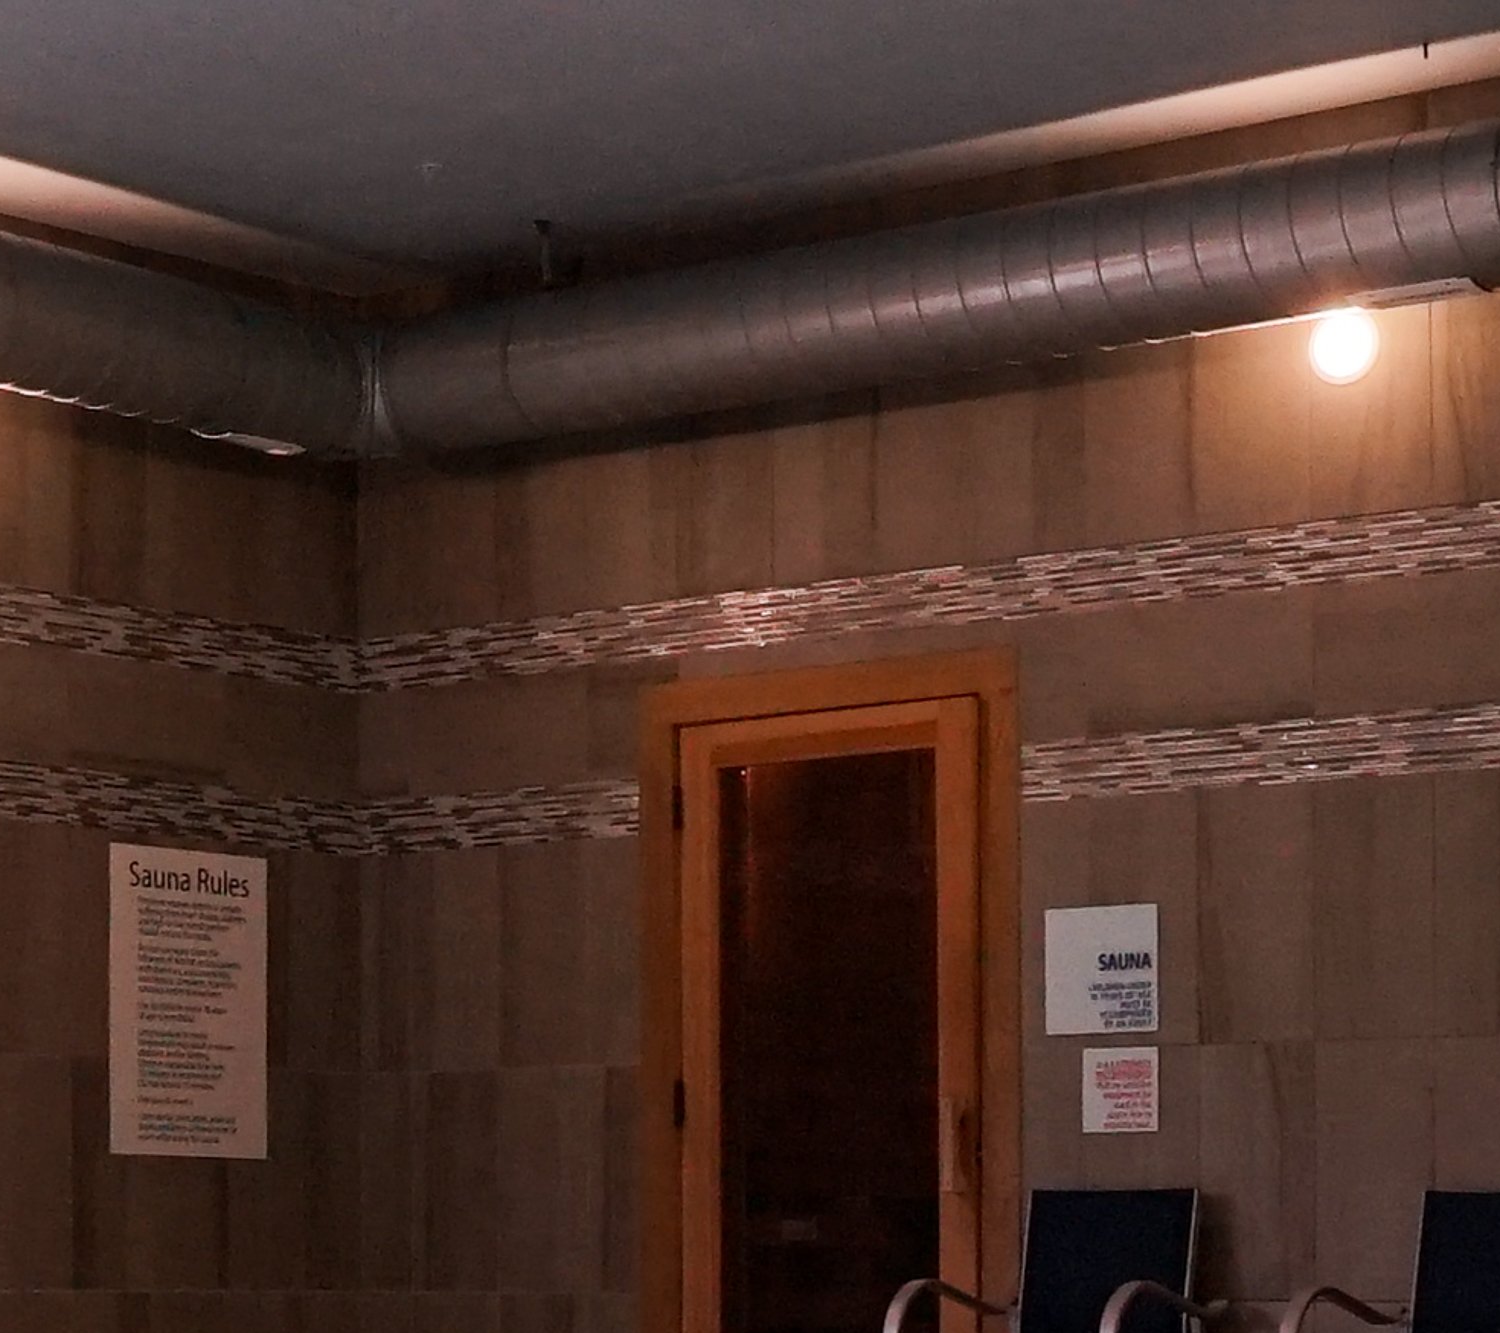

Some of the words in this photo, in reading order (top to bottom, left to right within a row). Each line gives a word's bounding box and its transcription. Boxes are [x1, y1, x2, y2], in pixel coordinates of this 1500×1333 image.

[129, 861, 190, 892] Sauna
[197, 867, 250, 898] Rules
[1098, 952, 1152, 971] SAUNA
